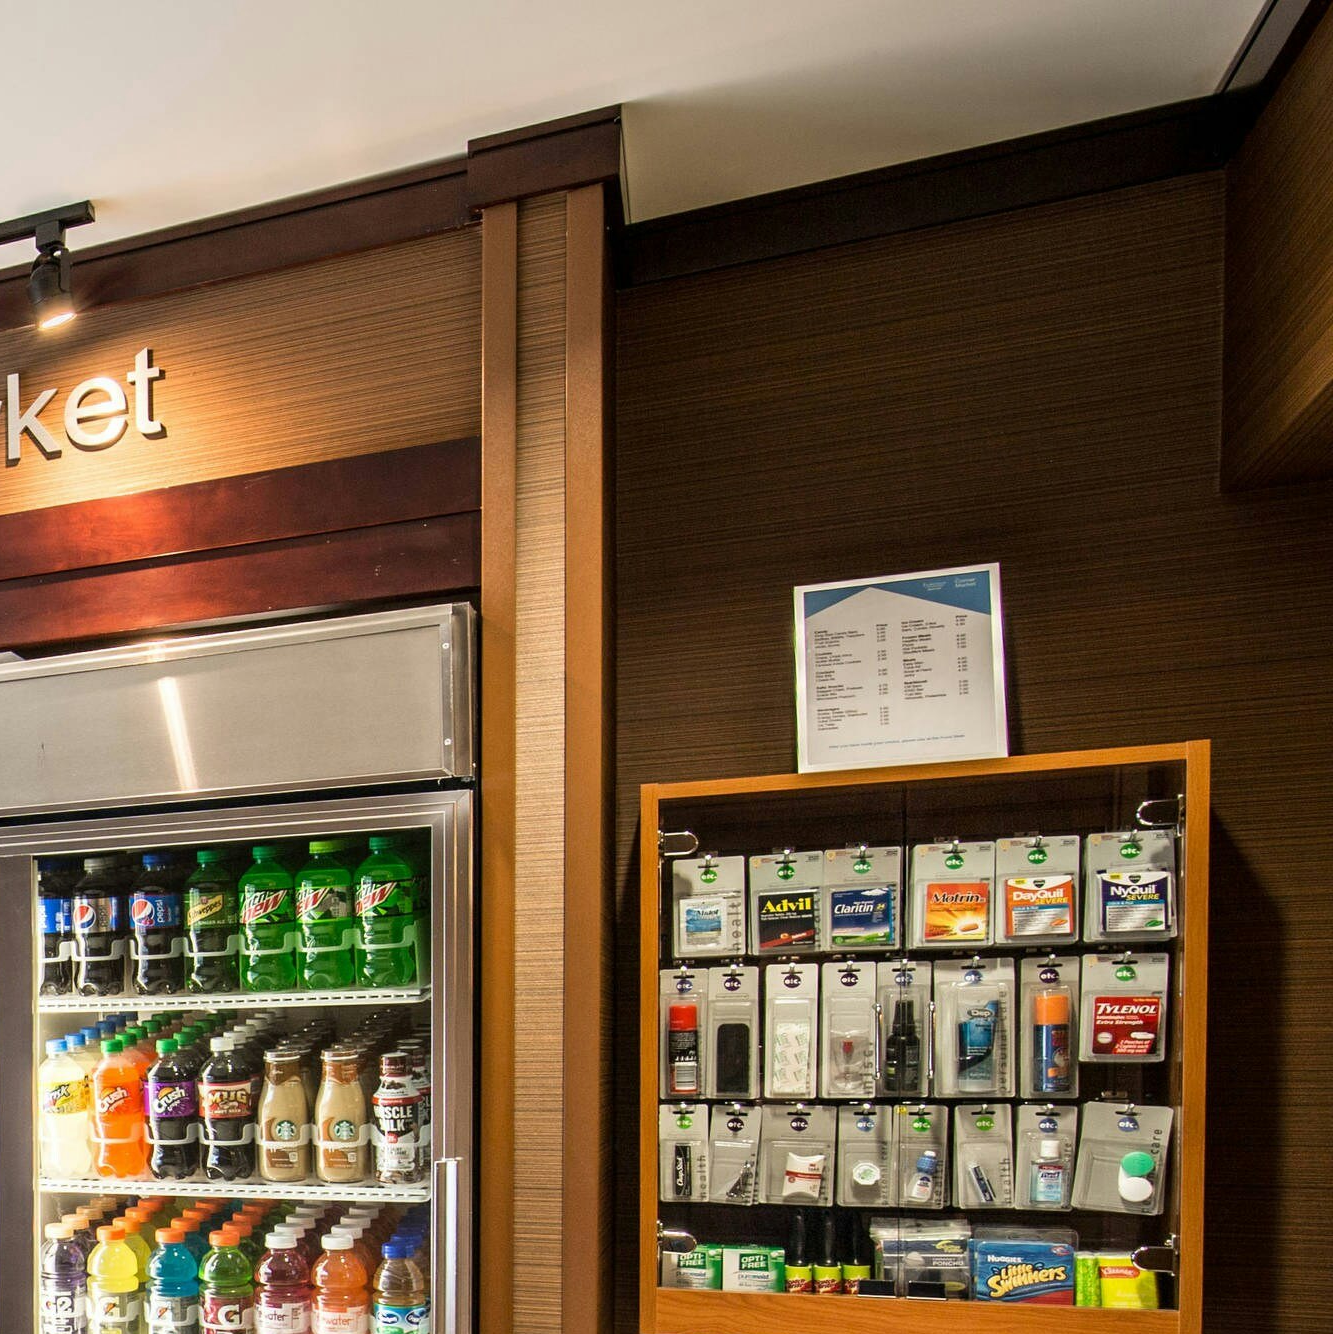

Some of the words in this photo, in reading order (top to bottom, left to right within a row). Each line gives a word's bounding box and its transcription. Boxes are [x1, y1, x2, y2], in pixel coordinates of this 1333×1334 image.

[1120, 847, 1141, 856] etc.
[1028, 853, 1048, 861] etc.
[945, 859, 964, 867] etc.
[1012, 888, 1064, 903] DayQuil
[1110, 883, 1156, 900] NyQuil
[932, 891, 981, 904] Motrin
[1035, 896, 1069, 905] SEVERE
[1126, 893, 1160, 901] SEVERE
[760, 896, 812, 913] Advil
[833, 903, 874, 915] Claritin
[156, 899, 165, 923] pepsi
[1040, 972, 1060, 980] etc.
[1115, 970, 1136, 979] etc.
[1096, 1002, 1158, 1015] TYLENOL
[208, 1087, 248, 1103] MUG
[152, 1087, 186, 1114] Crush
[911, 1121, 931, 1130] etc.
[975, 1119, 995, 1128] etc.
[1039, 1121, 1058, 1129] etc.
[1118, 1120, 1138, 1129] etc.
[741, 1261, 767, 1269] FREE
[987, 1265, 1068, 1298] Swimmers
[217, 1304, 240, 1325] G
